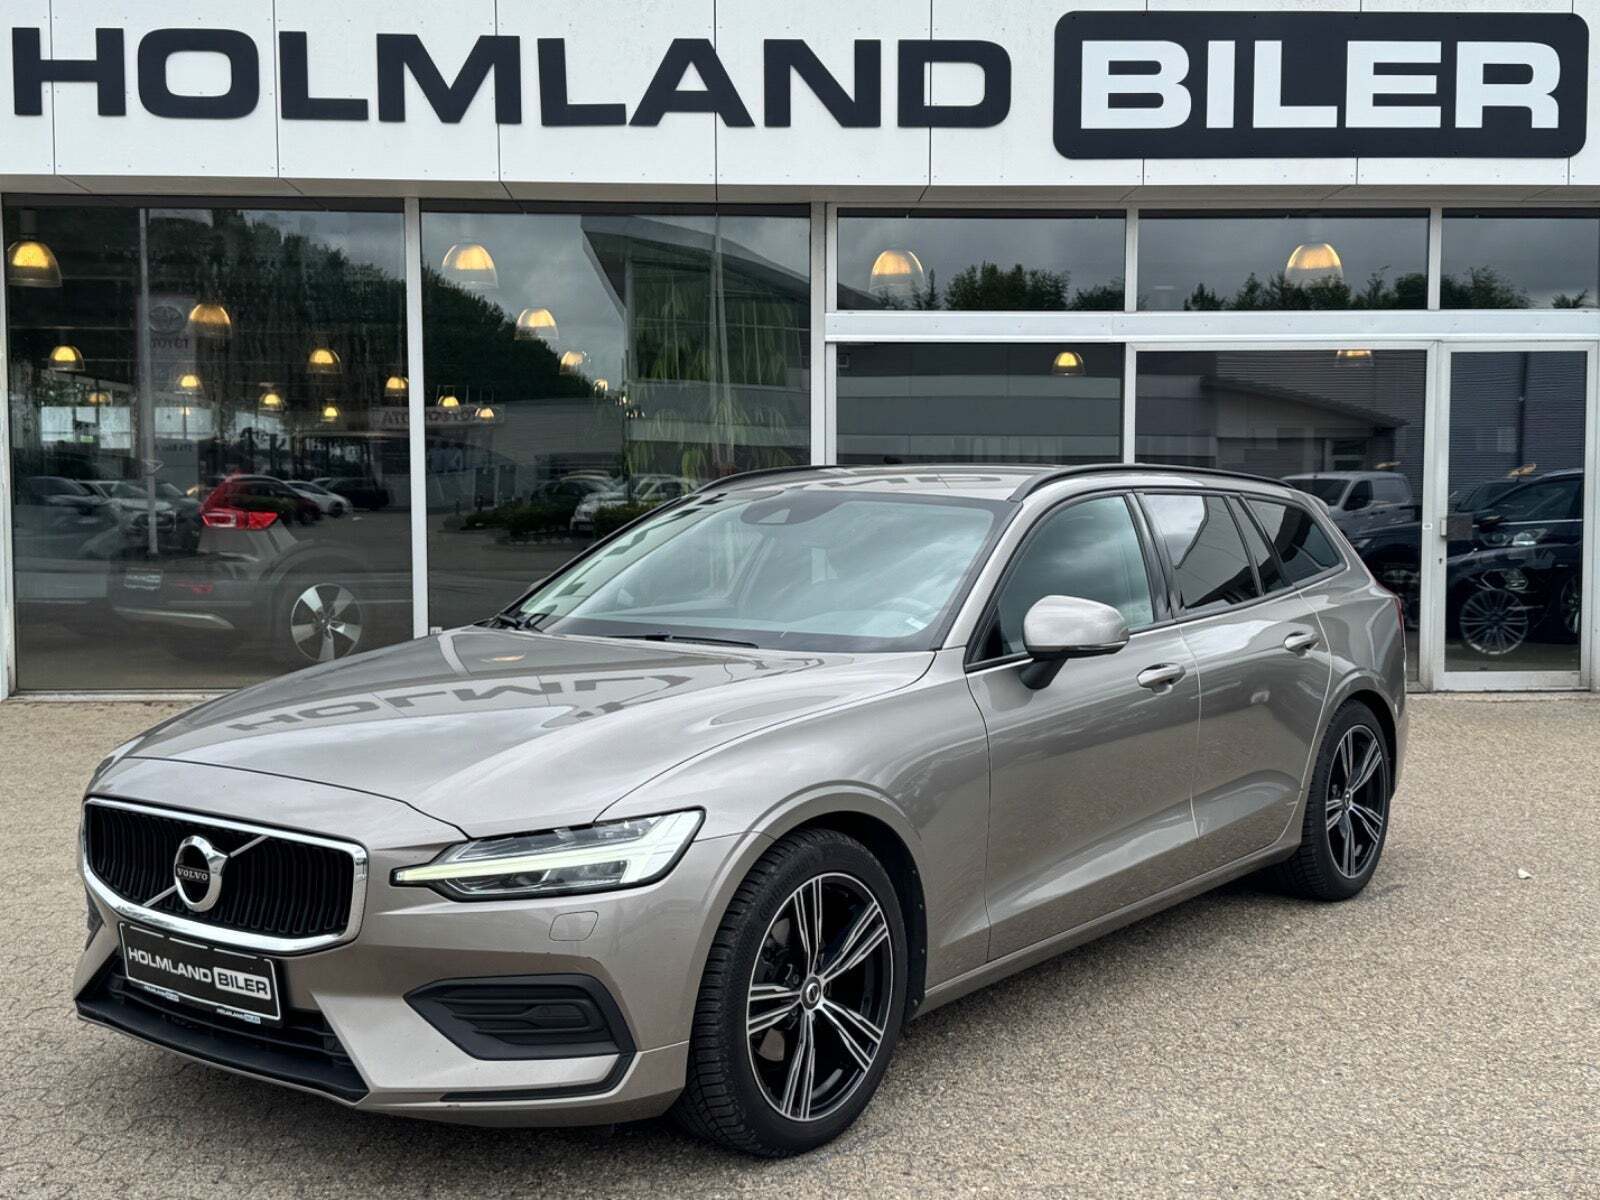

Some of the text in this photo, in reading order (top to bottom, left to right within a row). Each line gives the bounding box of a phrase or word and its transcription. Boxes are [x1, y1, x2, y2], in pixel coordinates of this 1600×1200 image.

[12, 28, 1560, 130] HOLMLAND BILER
[177, 868, 208, 880] VOLVO
[128, 947, 268, 996] HOLMLAND BILER
